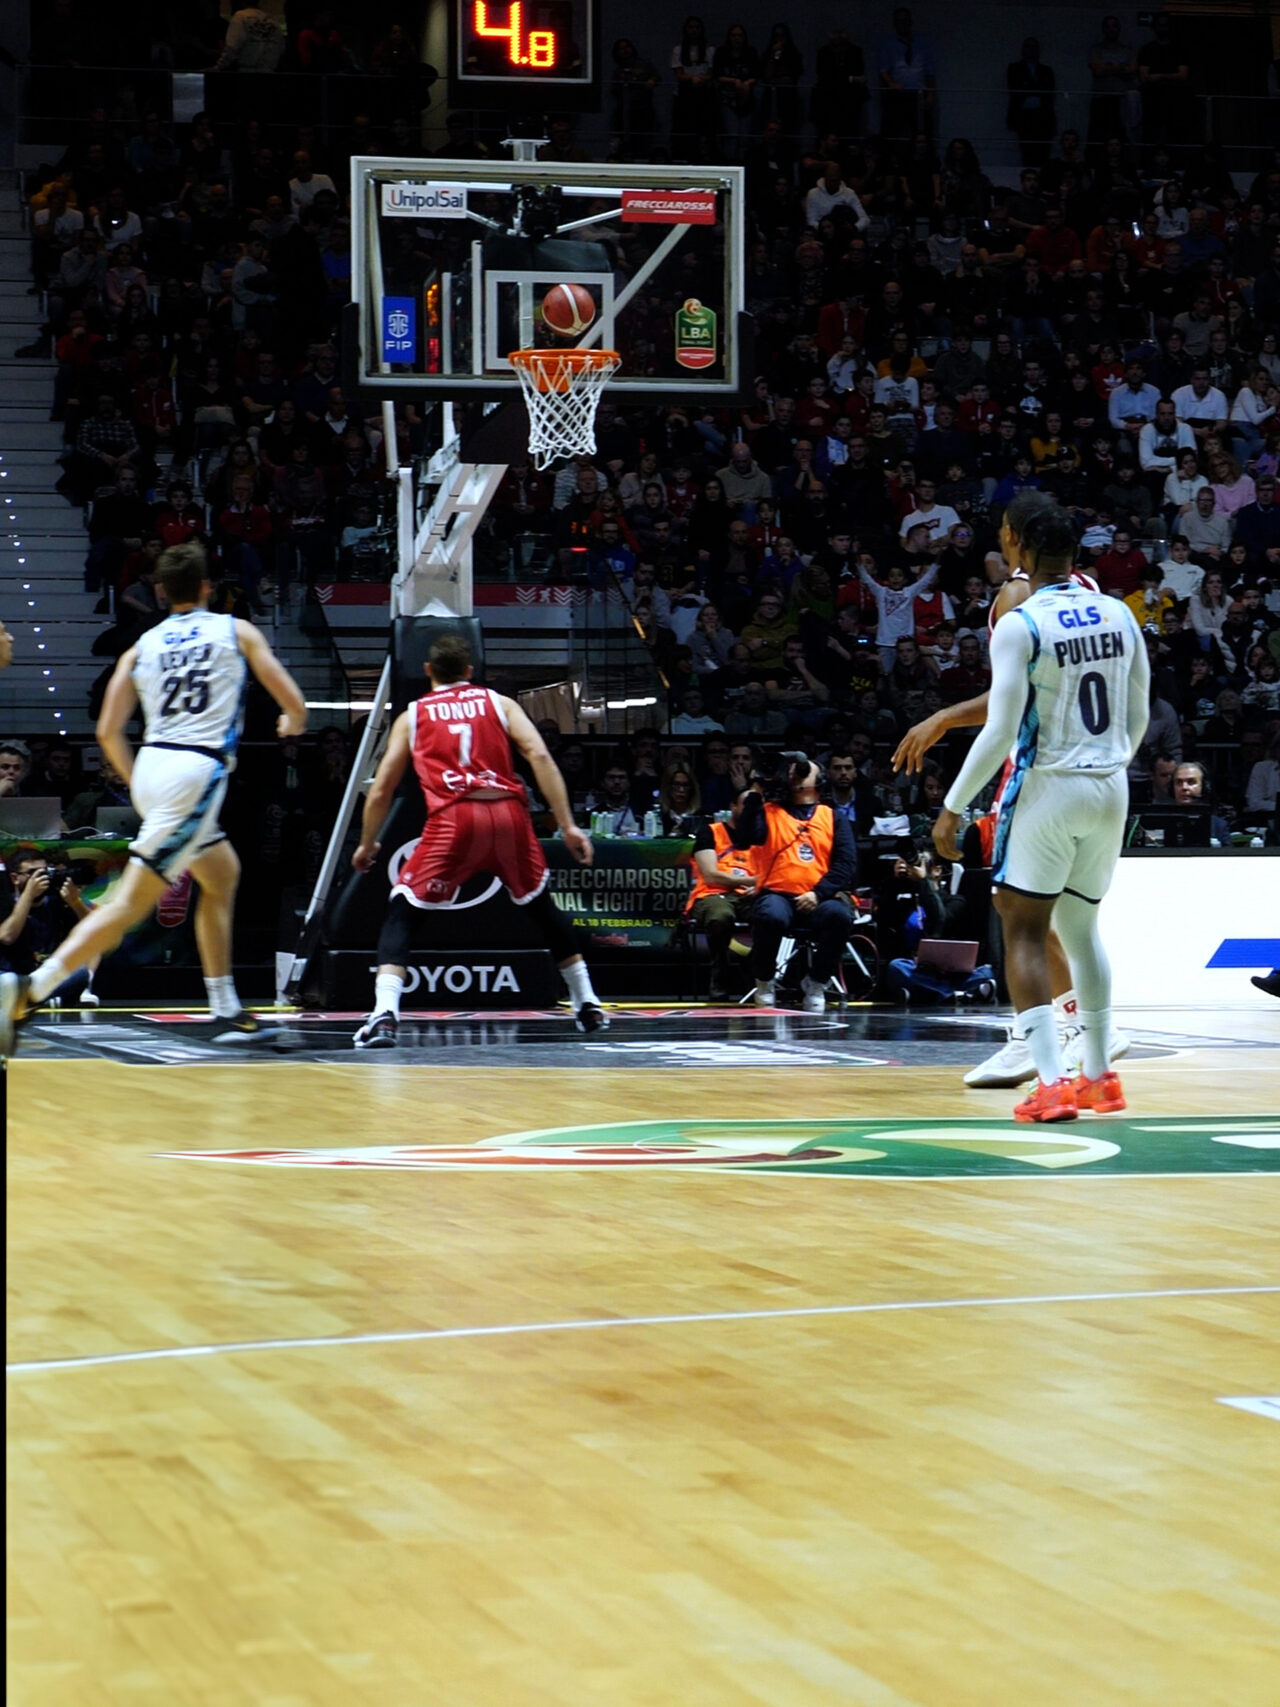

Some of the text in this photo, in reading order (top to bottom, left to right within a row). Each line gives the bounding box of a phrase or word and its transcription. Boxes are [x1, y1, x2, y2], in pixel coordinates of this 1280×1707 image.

[475, 0, 555, 67] 4.8
[391, 189, 464, 212] UnipolSai
[626, 200, 714, 211] FRECCIAROSSA
[681, 327, 711, 339] LBA
[385, 341, 412, 350] FIP
[1054, 631, 1125, 668] PULLEN
[160, 669, 210, 717] 25
[1078, 671, 1111, 736] 0
[425, 699, 487, 722] TONUT
[448, 723, 472, 767] 7
[593, 892, 647, 912] EIGHT
[601, 918, 653, 928] FEBBRAIO
